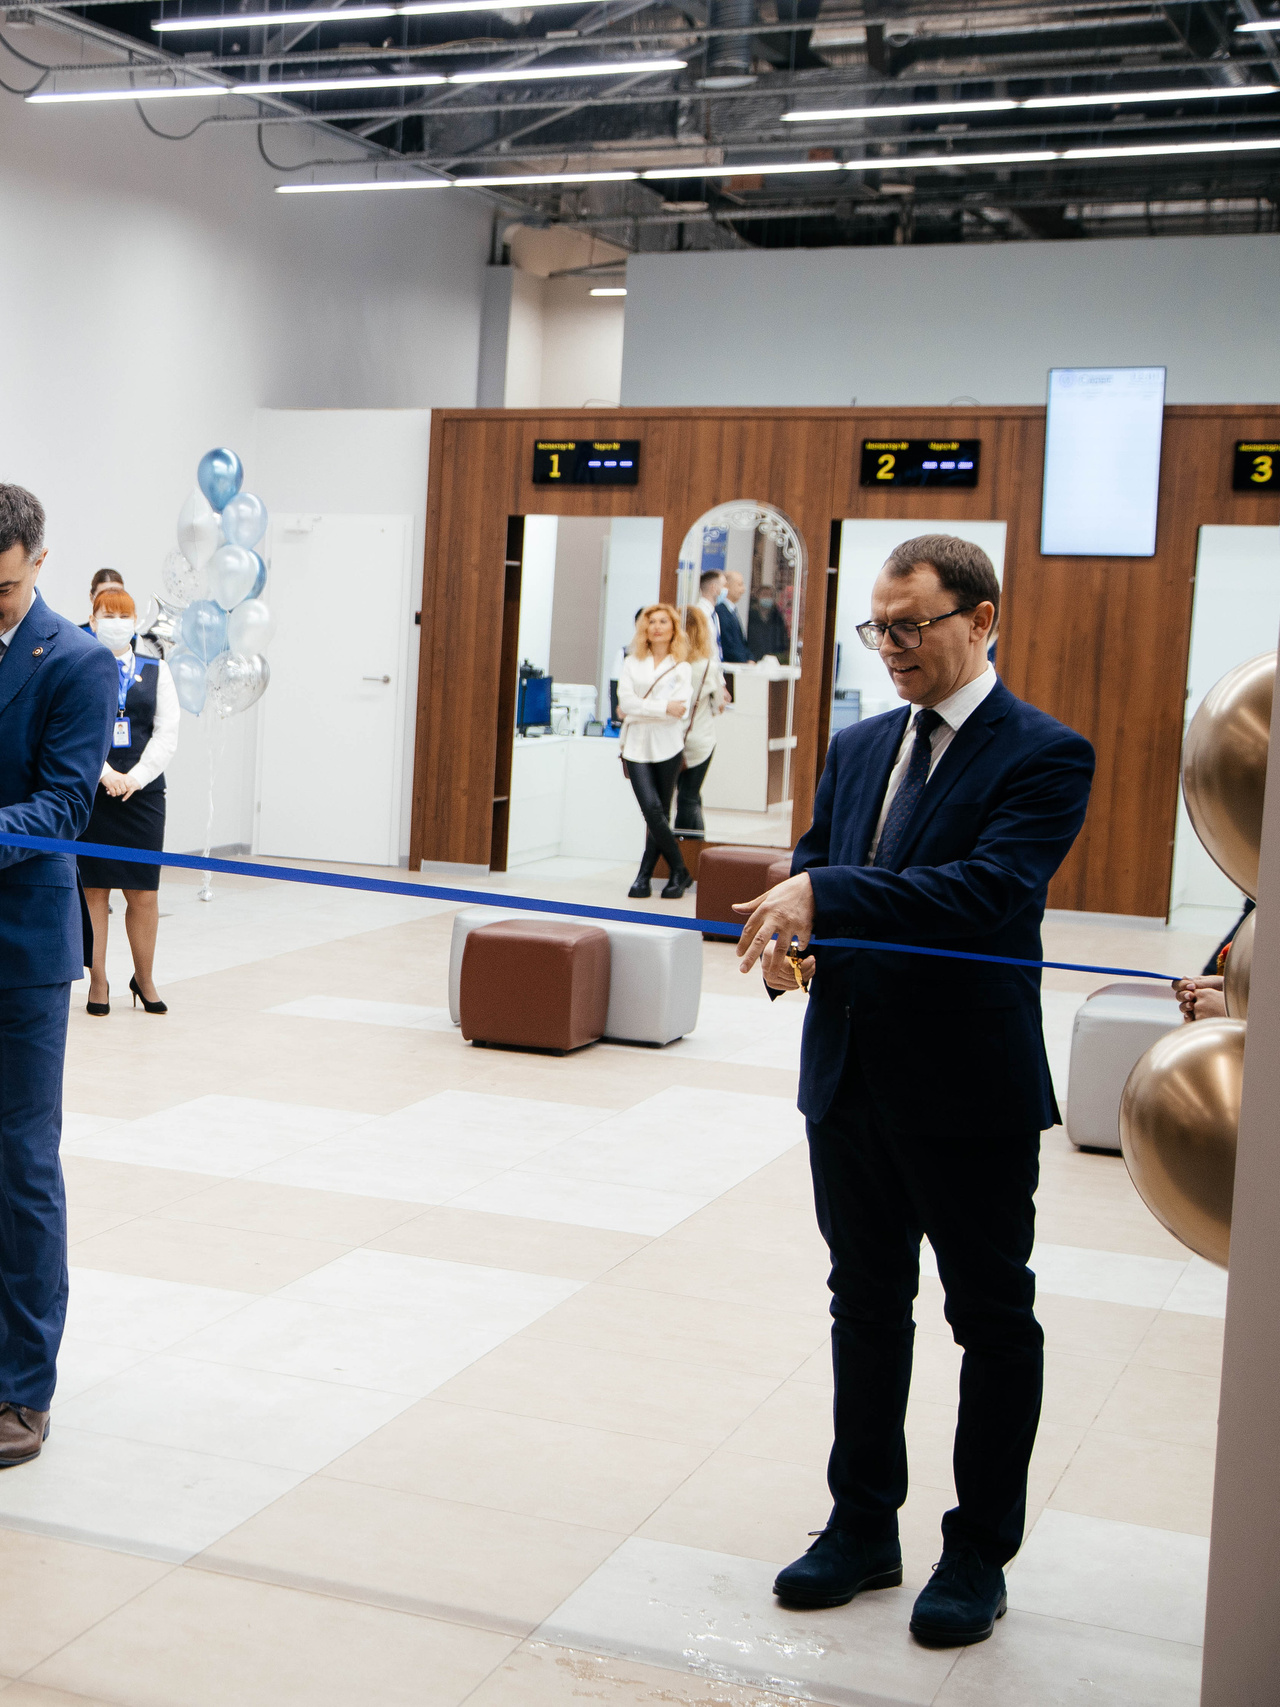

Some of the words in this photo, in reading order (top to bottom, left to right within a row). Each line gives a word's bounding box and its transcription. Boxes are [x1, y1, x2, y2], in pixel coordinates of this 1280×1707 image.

[549, 453, 561, 478] 1
[876, 453, 896, 480] 2
[1250, 455, 1273, 483] 3
